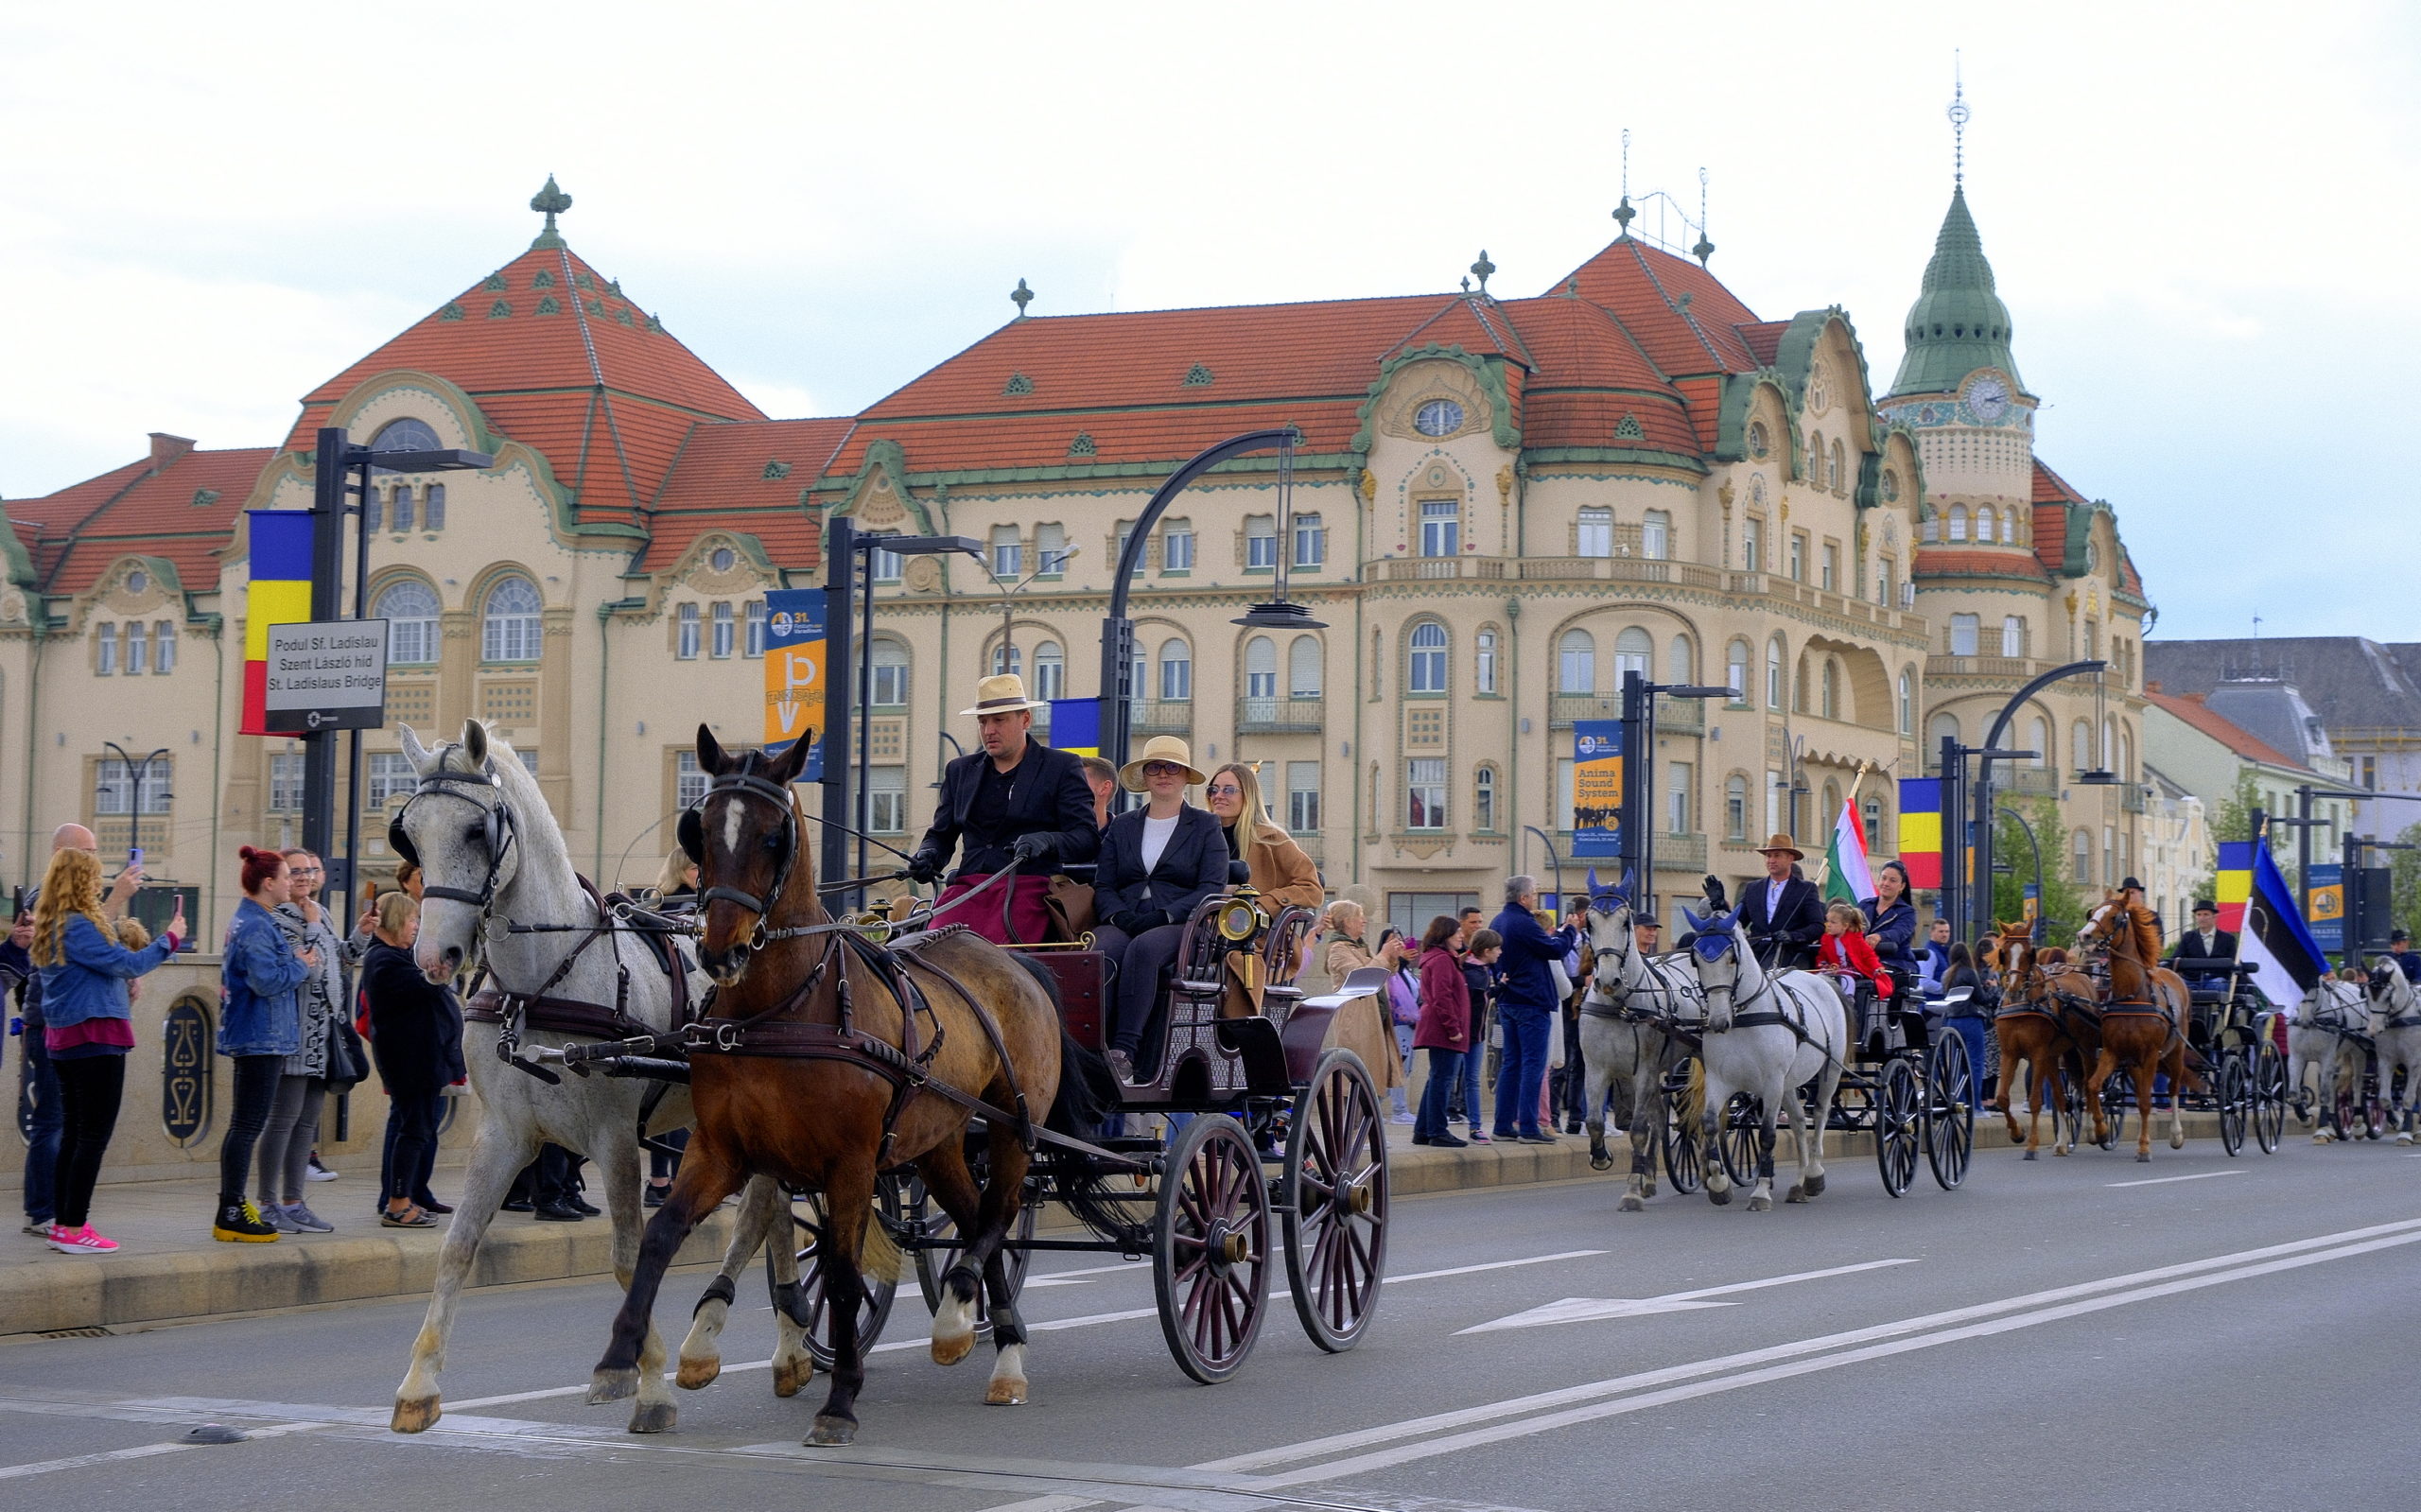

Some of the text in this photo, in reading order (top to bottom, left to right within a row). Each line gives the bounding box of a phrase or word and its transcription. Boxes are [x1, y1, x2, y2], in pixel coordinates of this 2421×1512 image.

[275, 635, 378, 652] Podul Sf. Ladislau
[279, 658, 312, 671] Szent
[315, 655, 352, 669] László
[269, 674, 381, 690] St. Ladislaus Bridge
[1578, 769, 1615, 777] Anima
[1578, 778, 1613, 788] Sound
[1578, 789, 1619, 800] System
